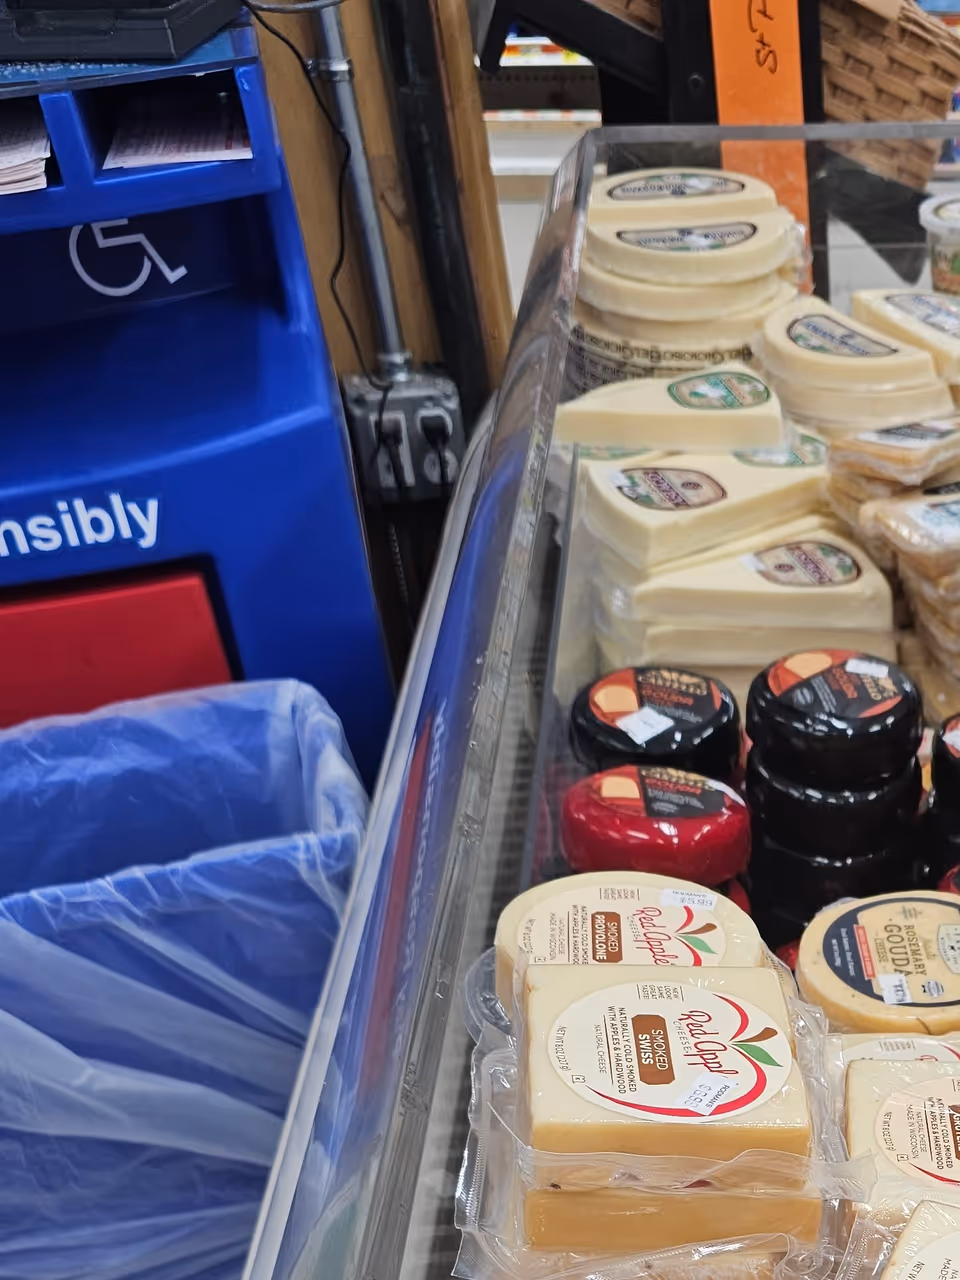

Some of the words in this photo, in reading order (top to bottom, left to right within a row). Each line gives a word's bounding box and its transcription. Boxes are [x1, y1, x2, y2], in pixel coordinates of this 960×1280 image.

[606, 921, 619, 953] SMOKED
[635, 906, 667, 930] Red
[594, 914, 607, 961] PROVOLONE
[633, 931, 679, 965] Apple
[884, 924, 908, 977] GOUDA
[904, 924, 927, 976] ROSEMARY
[638, 1033, 654, 1065] SWISS
[651, 1029, 669, 1071] SMOKED
[616, 1051, 627, 1094] HARDWOOD
[939, 1258, 952, 1280] MADE
